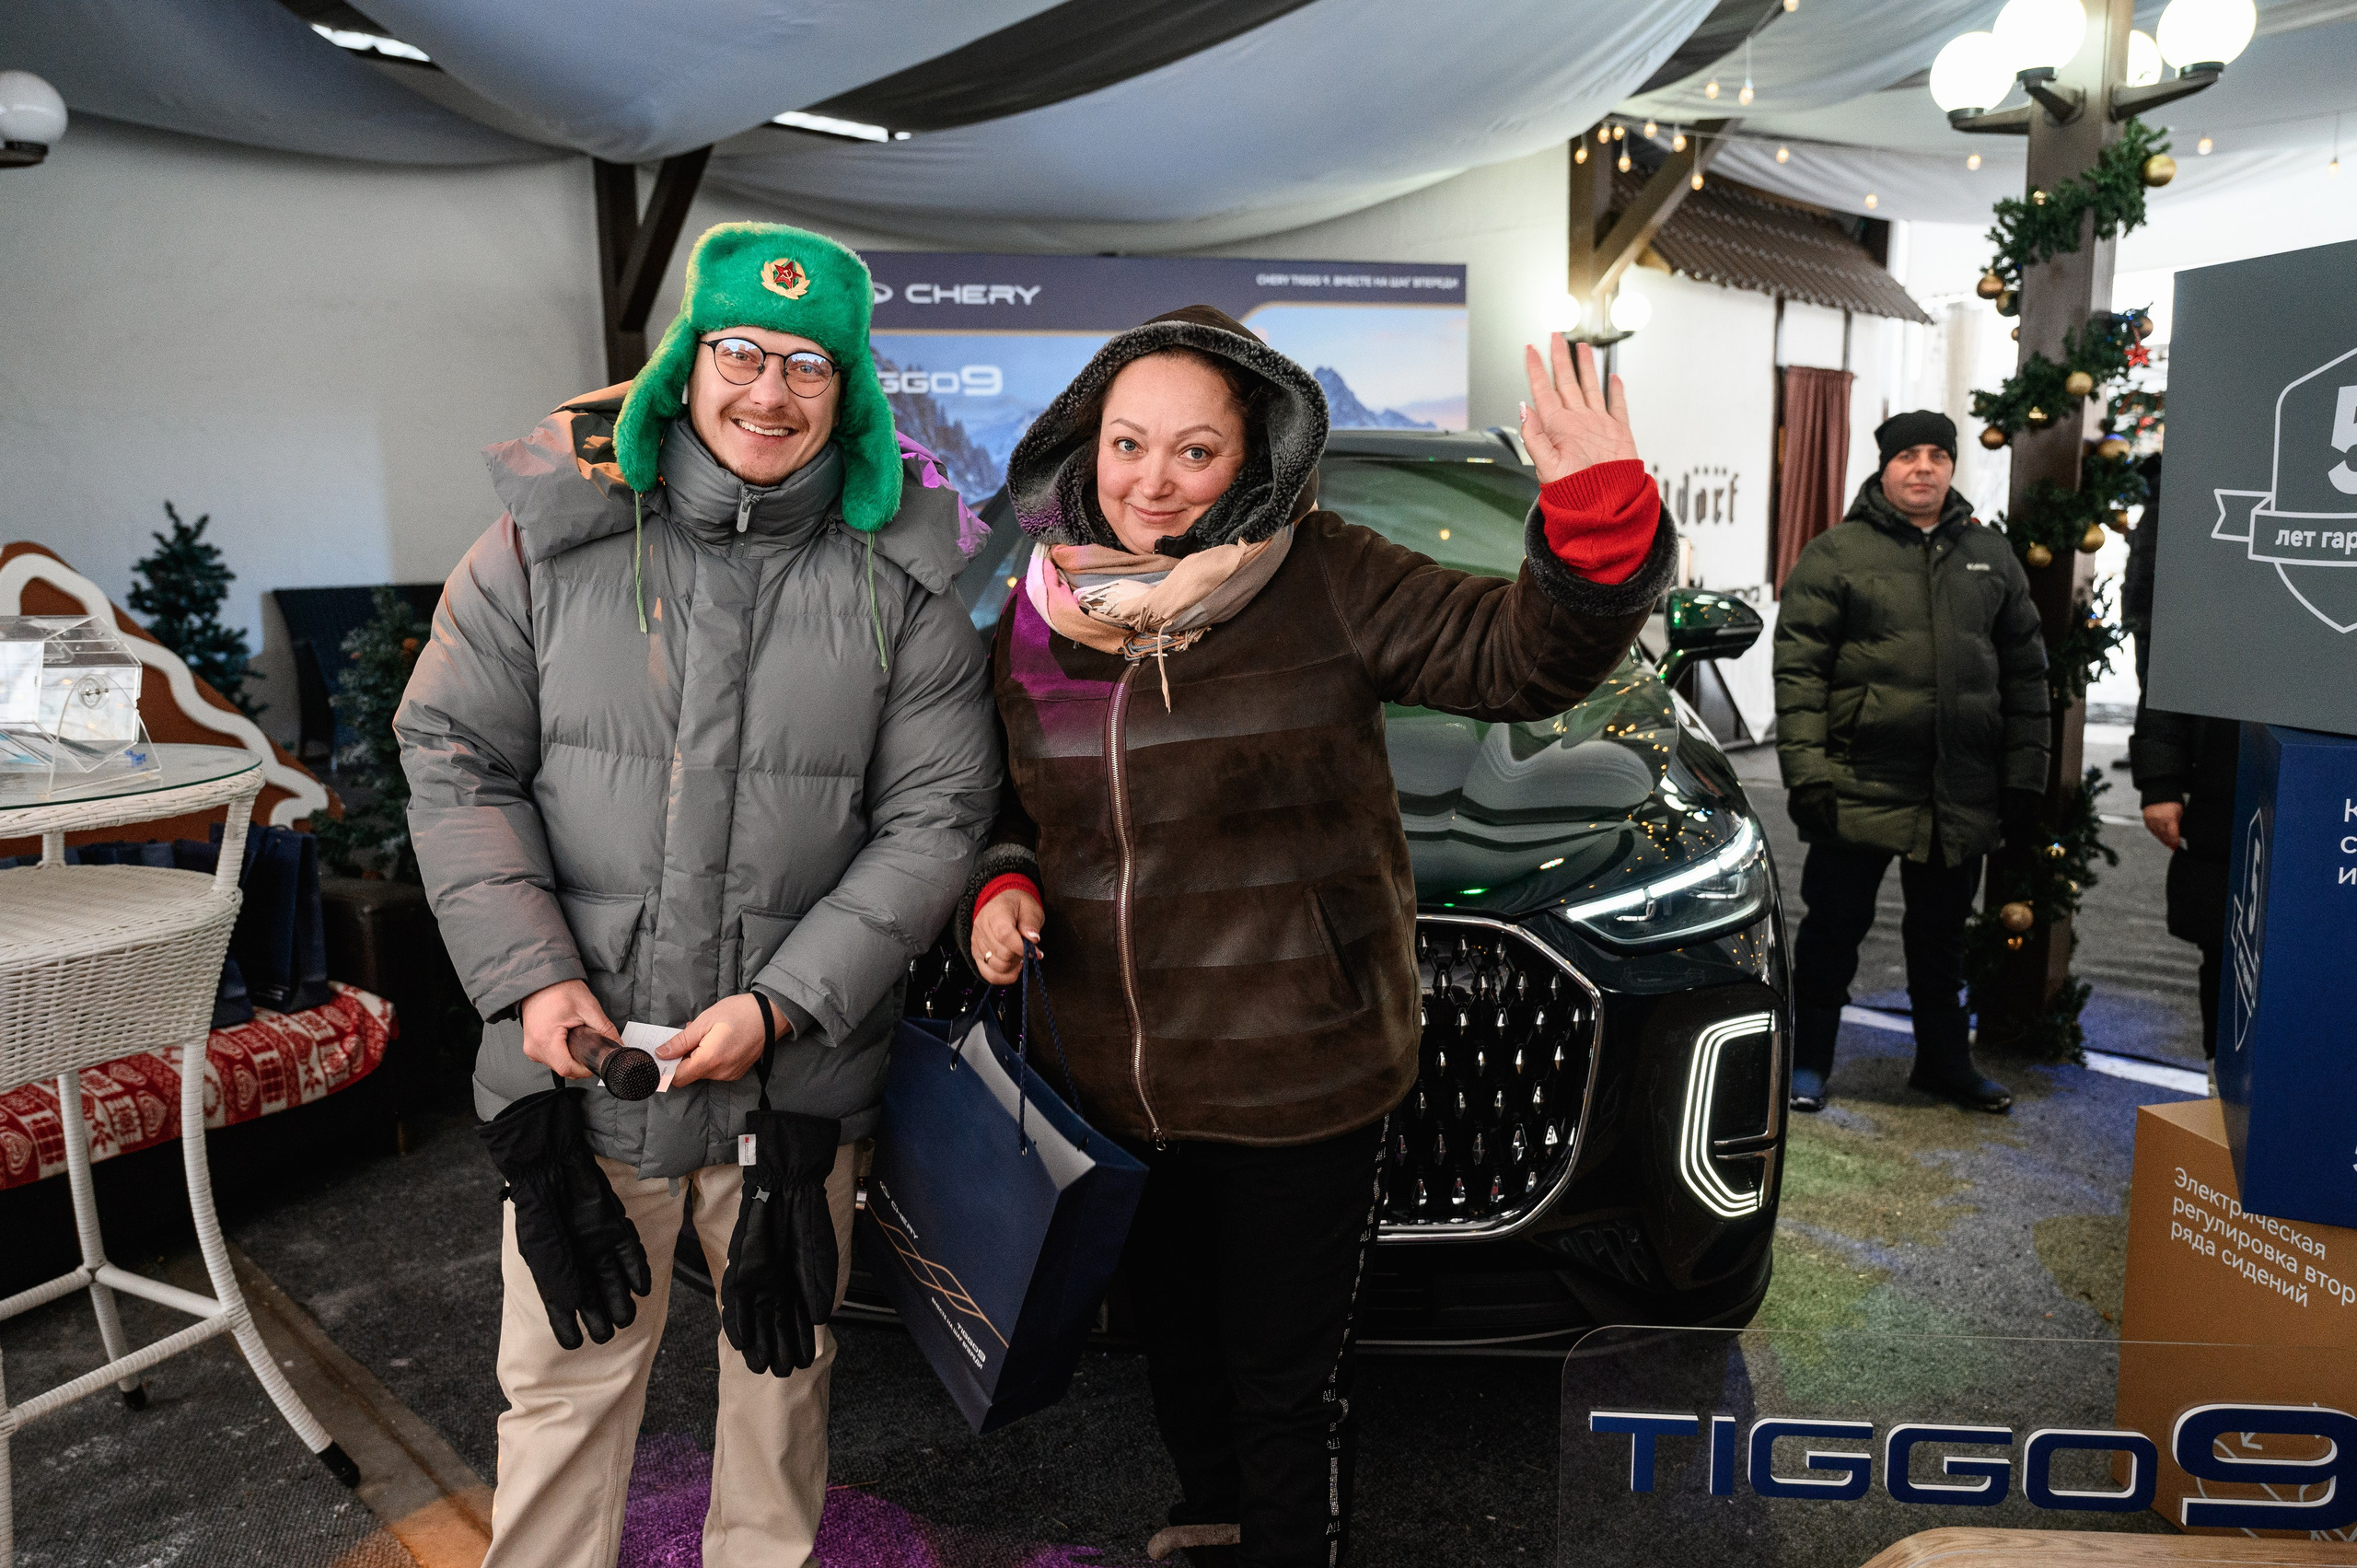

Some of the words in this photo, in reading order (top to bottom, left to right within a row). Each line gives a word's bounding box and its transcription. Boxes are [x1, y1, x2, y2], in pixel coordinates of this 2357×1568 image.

[1256, 273, 1290, 286] CHERY
[905, 284, 1041, 306] CHERY
[2275, 529, 2316, 548] лет
[890, 1200, 919, 1239] CHERY
[2173, 1196, 2298, 1274] регулировка
[2171, 1221, 2216, 1257] ряда
[2222, 1249, 2308, 1307] сидений
